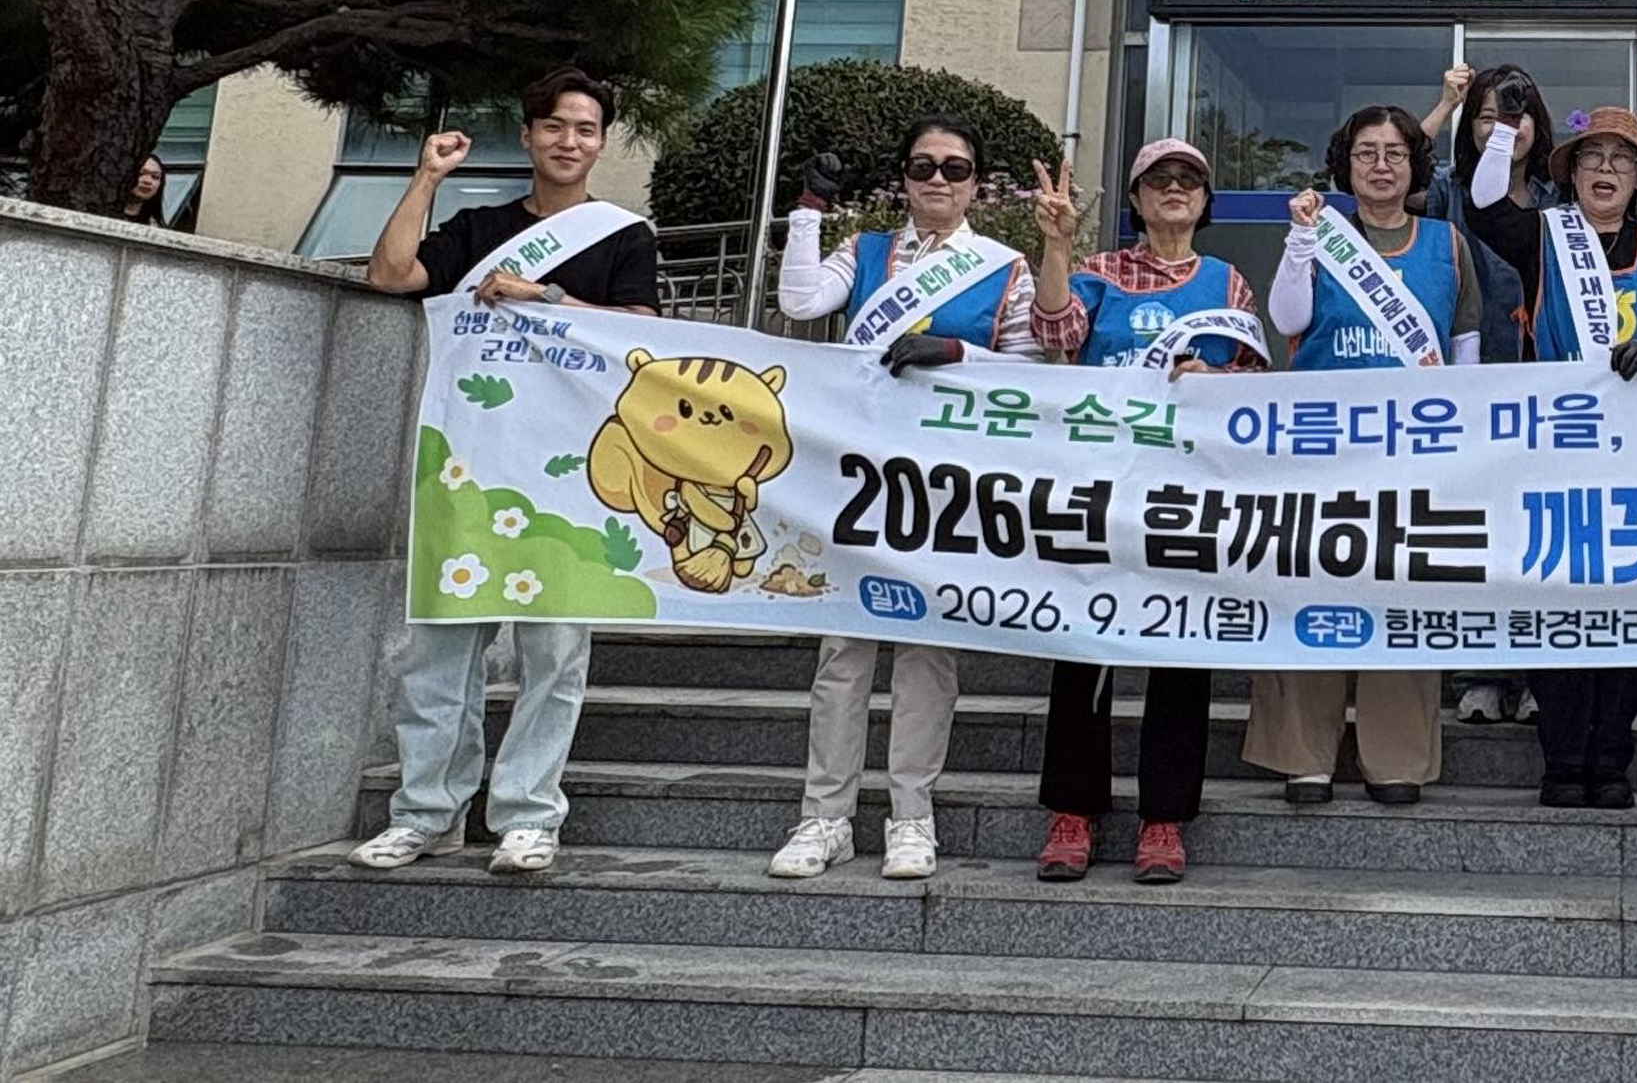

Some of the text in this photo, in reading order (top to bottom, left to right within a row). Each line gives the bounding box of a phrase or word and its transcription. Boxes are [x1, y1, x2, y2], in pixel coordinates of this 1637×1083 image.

[920, 384, 1040, 438] 고운
[1062, 394, 1195, 455] 손길,
[1227, 398, 1463, 456] 아름다운
[1490, 392, 1623, 452] 마을,
[832, 453, 1113, 565] 2026년
[1143, 484, 1488, 583] 함께하는
[866, 580, 919, 617] 일자
[935, 584, 1071, 633] 2026.
[1087, 595, 1126, 636] 9.
[1141, 595, 1269, 642] 21.(월)
[1306, 608, 1364, 646] 주관
[1385, 608, 1497, 650] 함평군
